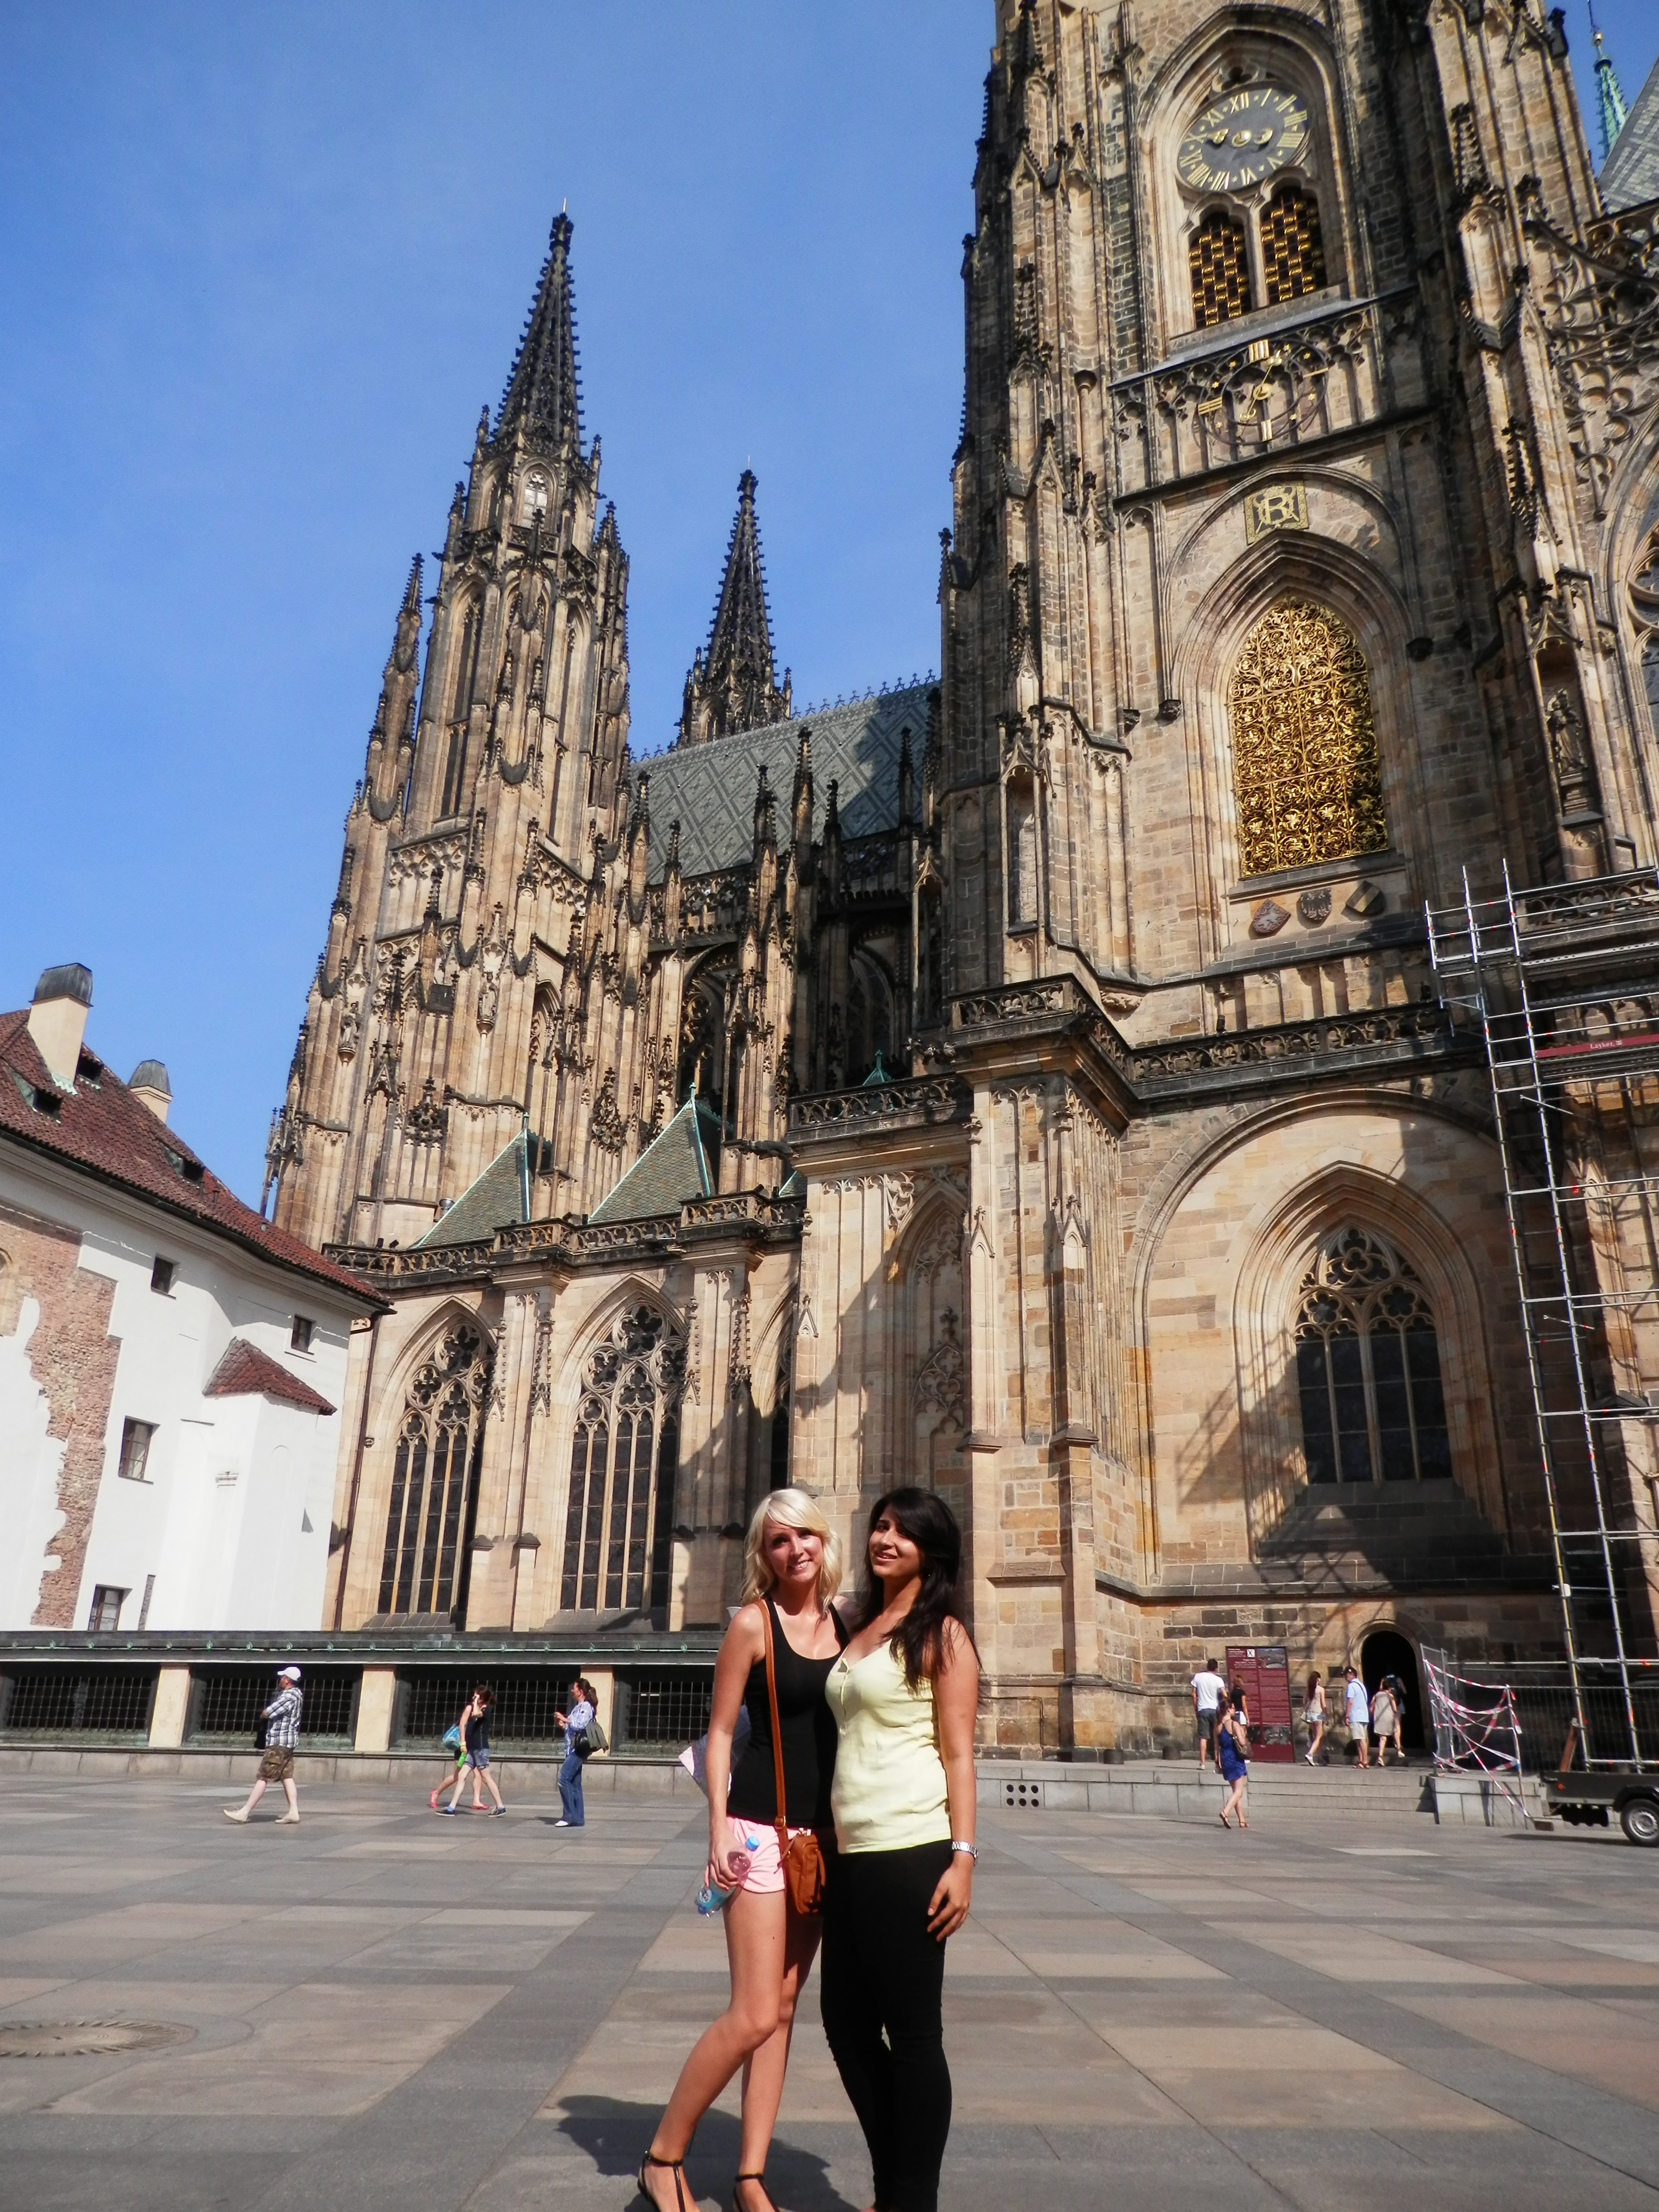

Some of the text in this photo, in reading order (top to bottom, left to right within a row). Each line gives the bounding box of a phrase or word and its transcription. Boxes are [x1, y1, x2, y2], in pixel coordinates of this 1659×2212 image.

[1229, 92, 1249, 113] XII
[1276, 94, 1297, 113] II
[1201, 108, 1224, 127] XI
[1284, 109, 1307, 128] III
[1267, 157, 1283, 170] V
[1187, 163, 1212, 188] VIII
[1209, 171, 1230, 191] VII
[1240, 167, 1258, 186] VI
